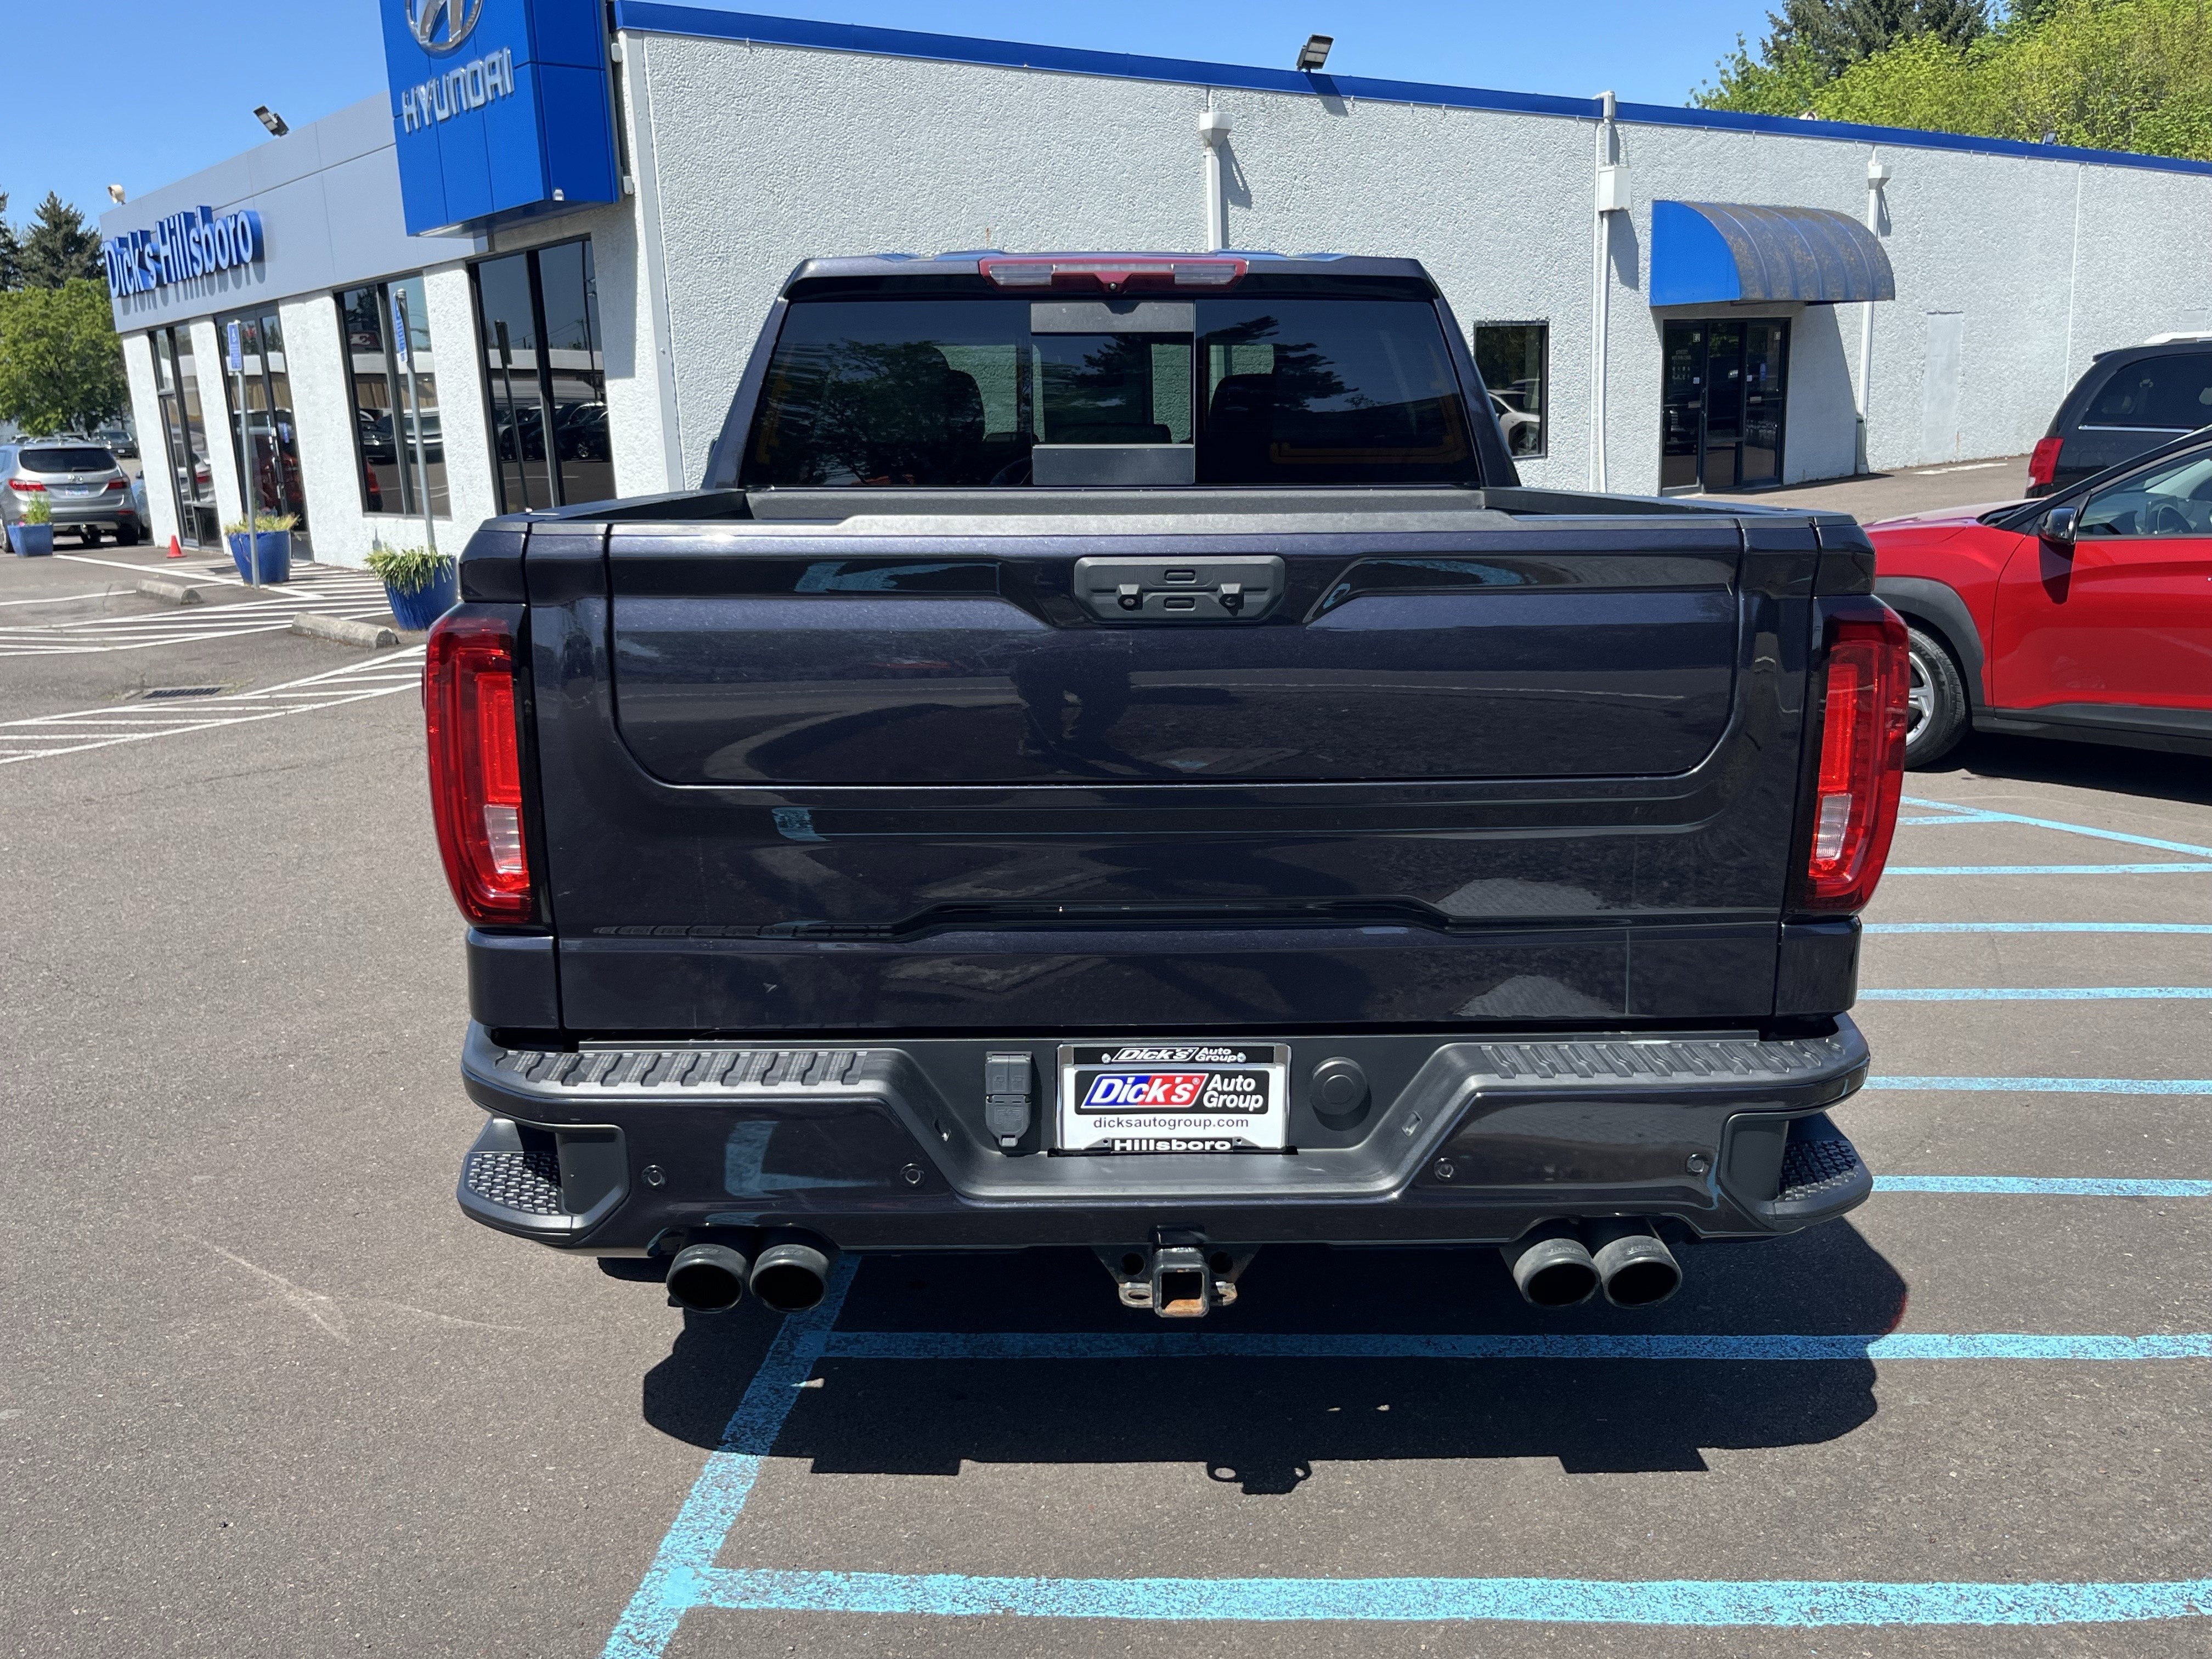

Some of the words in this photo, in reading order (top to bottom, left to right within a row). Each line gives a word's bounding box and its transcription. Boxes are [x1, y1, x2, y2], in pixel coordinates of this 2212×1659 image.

[402, 46, 515, 133] HYUNDAI
[104, 230, 157, 298] Dick's
[156, 206, 253, 285] Hillsboro
[1195, 1053, 1237, 1063] Group
[1206, 1074, 1256, 1092] Auto
[1203, 1091, 1263, 1111] Group
[1093, 1116, 1249, 1130] dicksautogroup.com
[1114, 1139, 1232, 1152] Hillsboro
